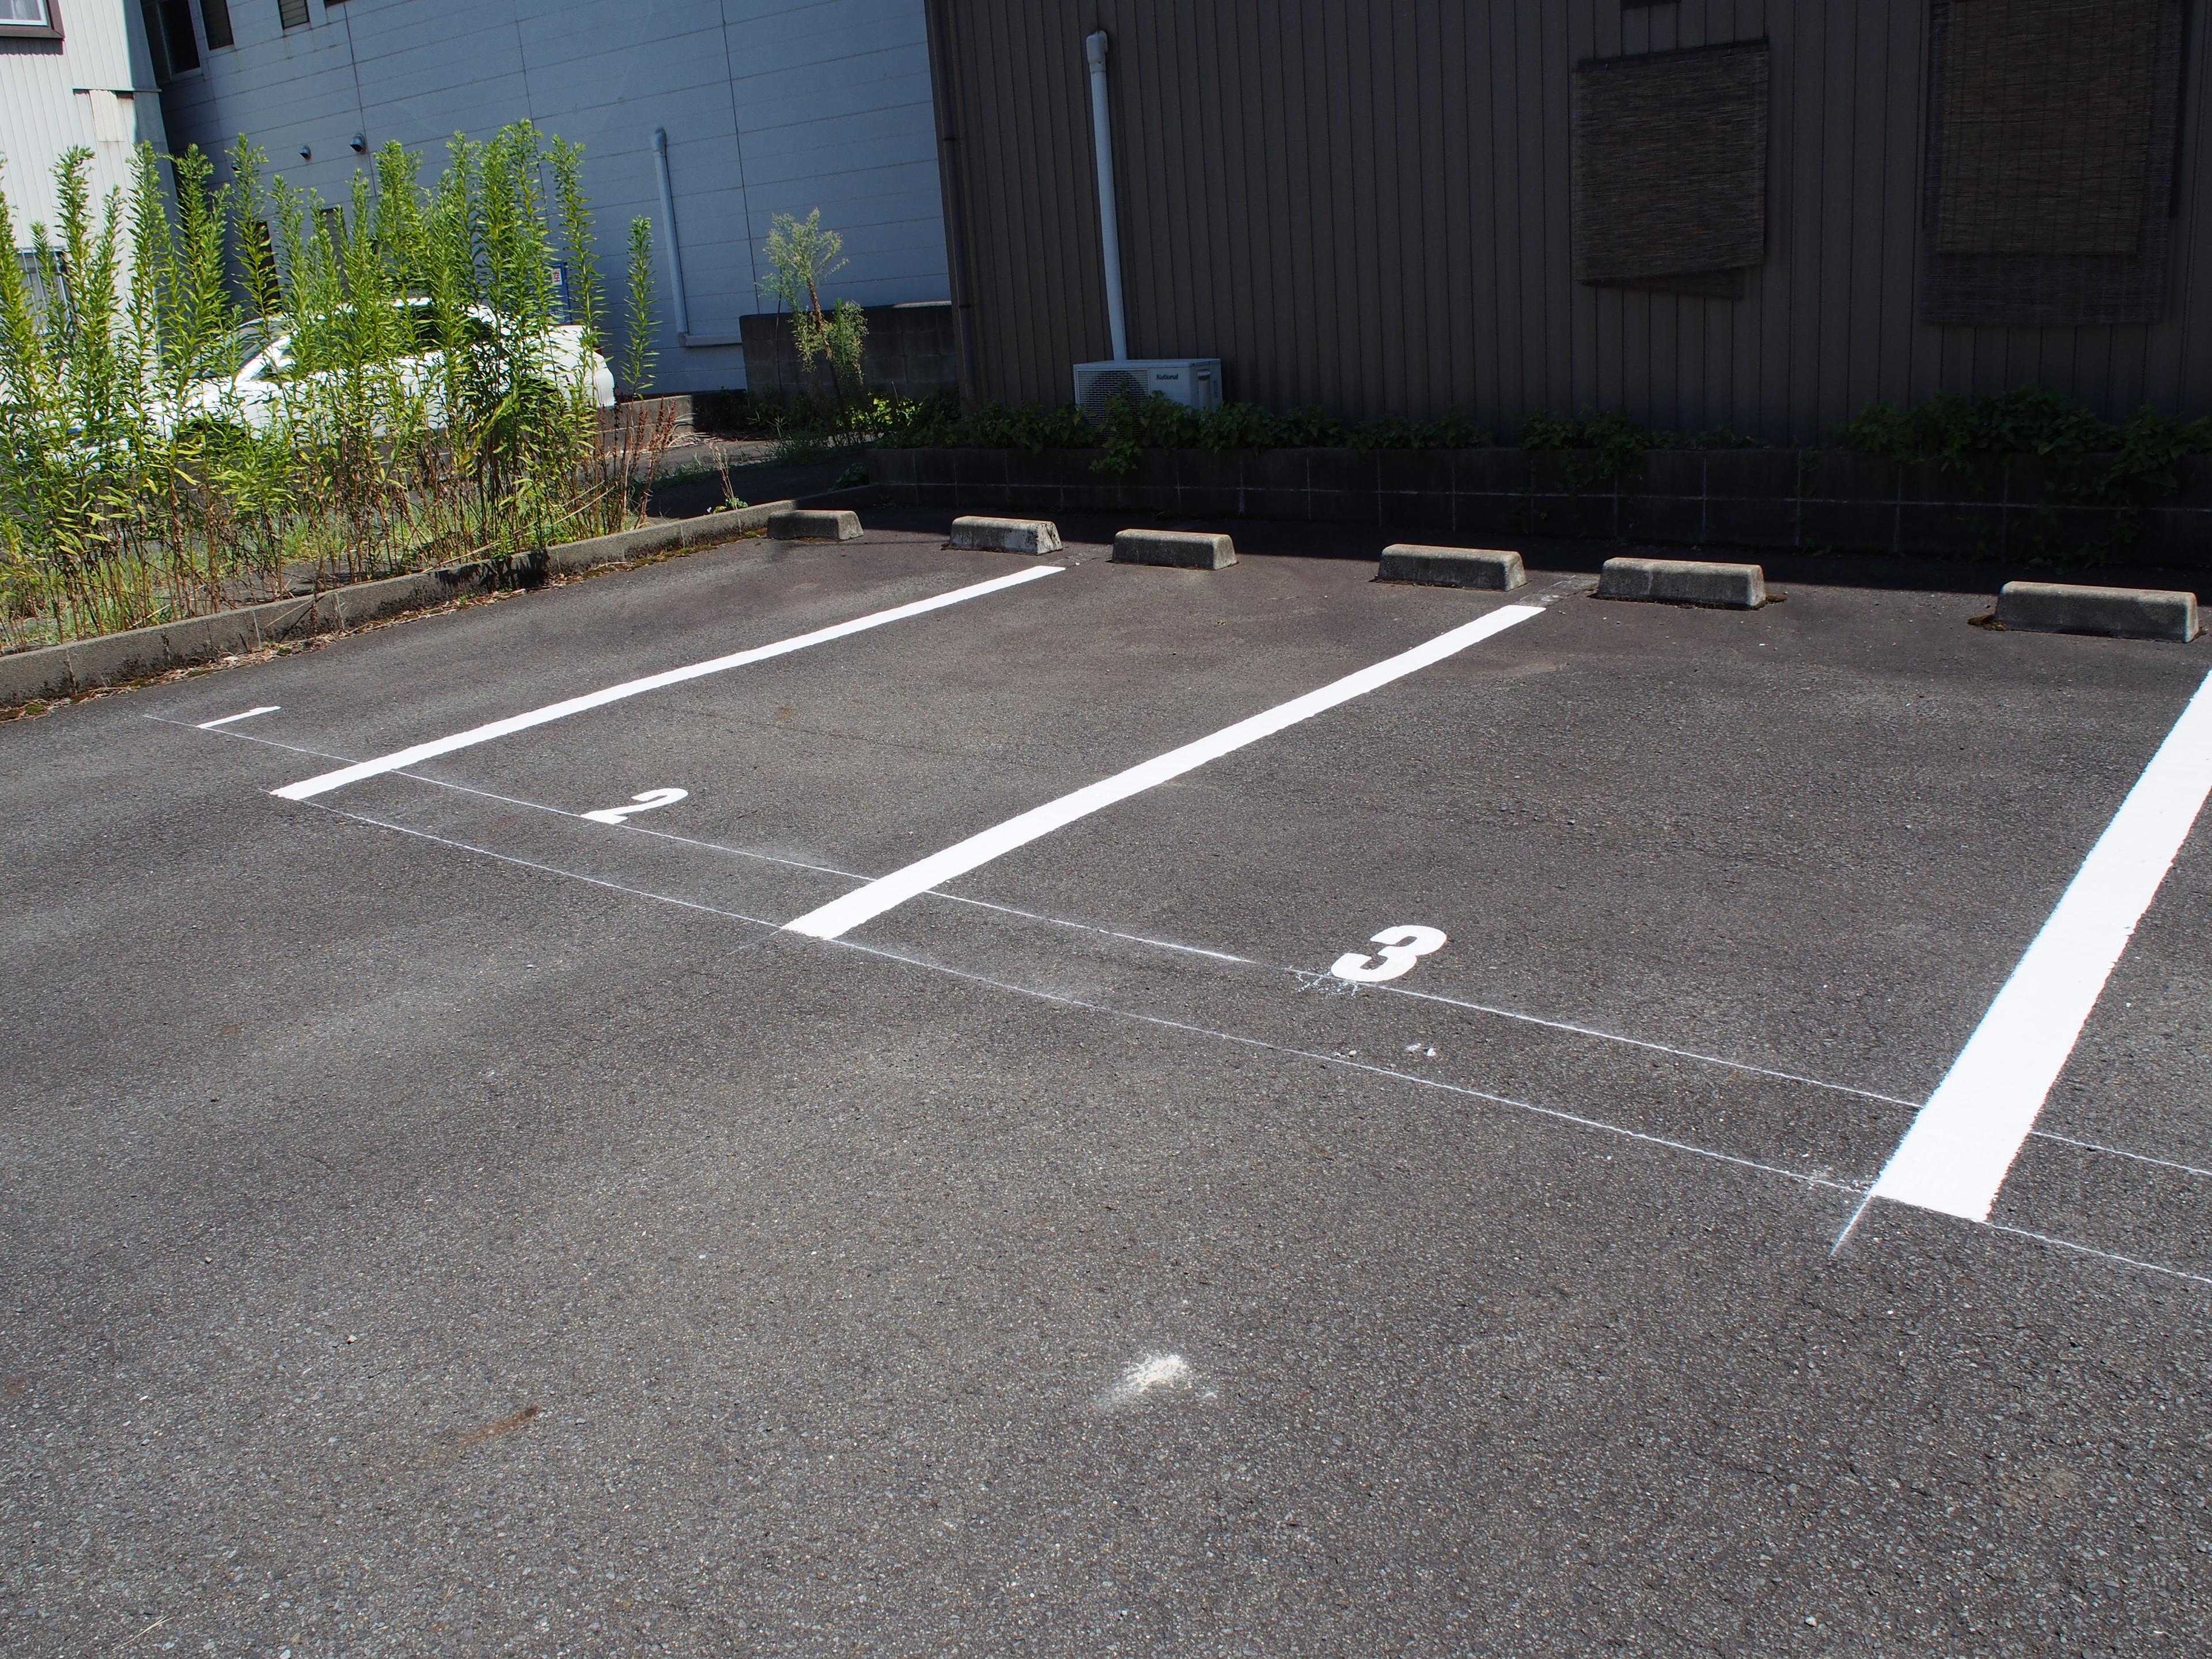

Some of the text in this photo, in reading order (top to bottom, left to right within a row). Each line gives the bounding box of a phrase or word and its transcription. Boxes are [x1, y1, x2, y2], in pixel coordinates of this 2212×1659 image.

[196, 706, 282, 729] 1
[579, 787, 689, 825] 2
[1330, 925, 1447, 982] 3
